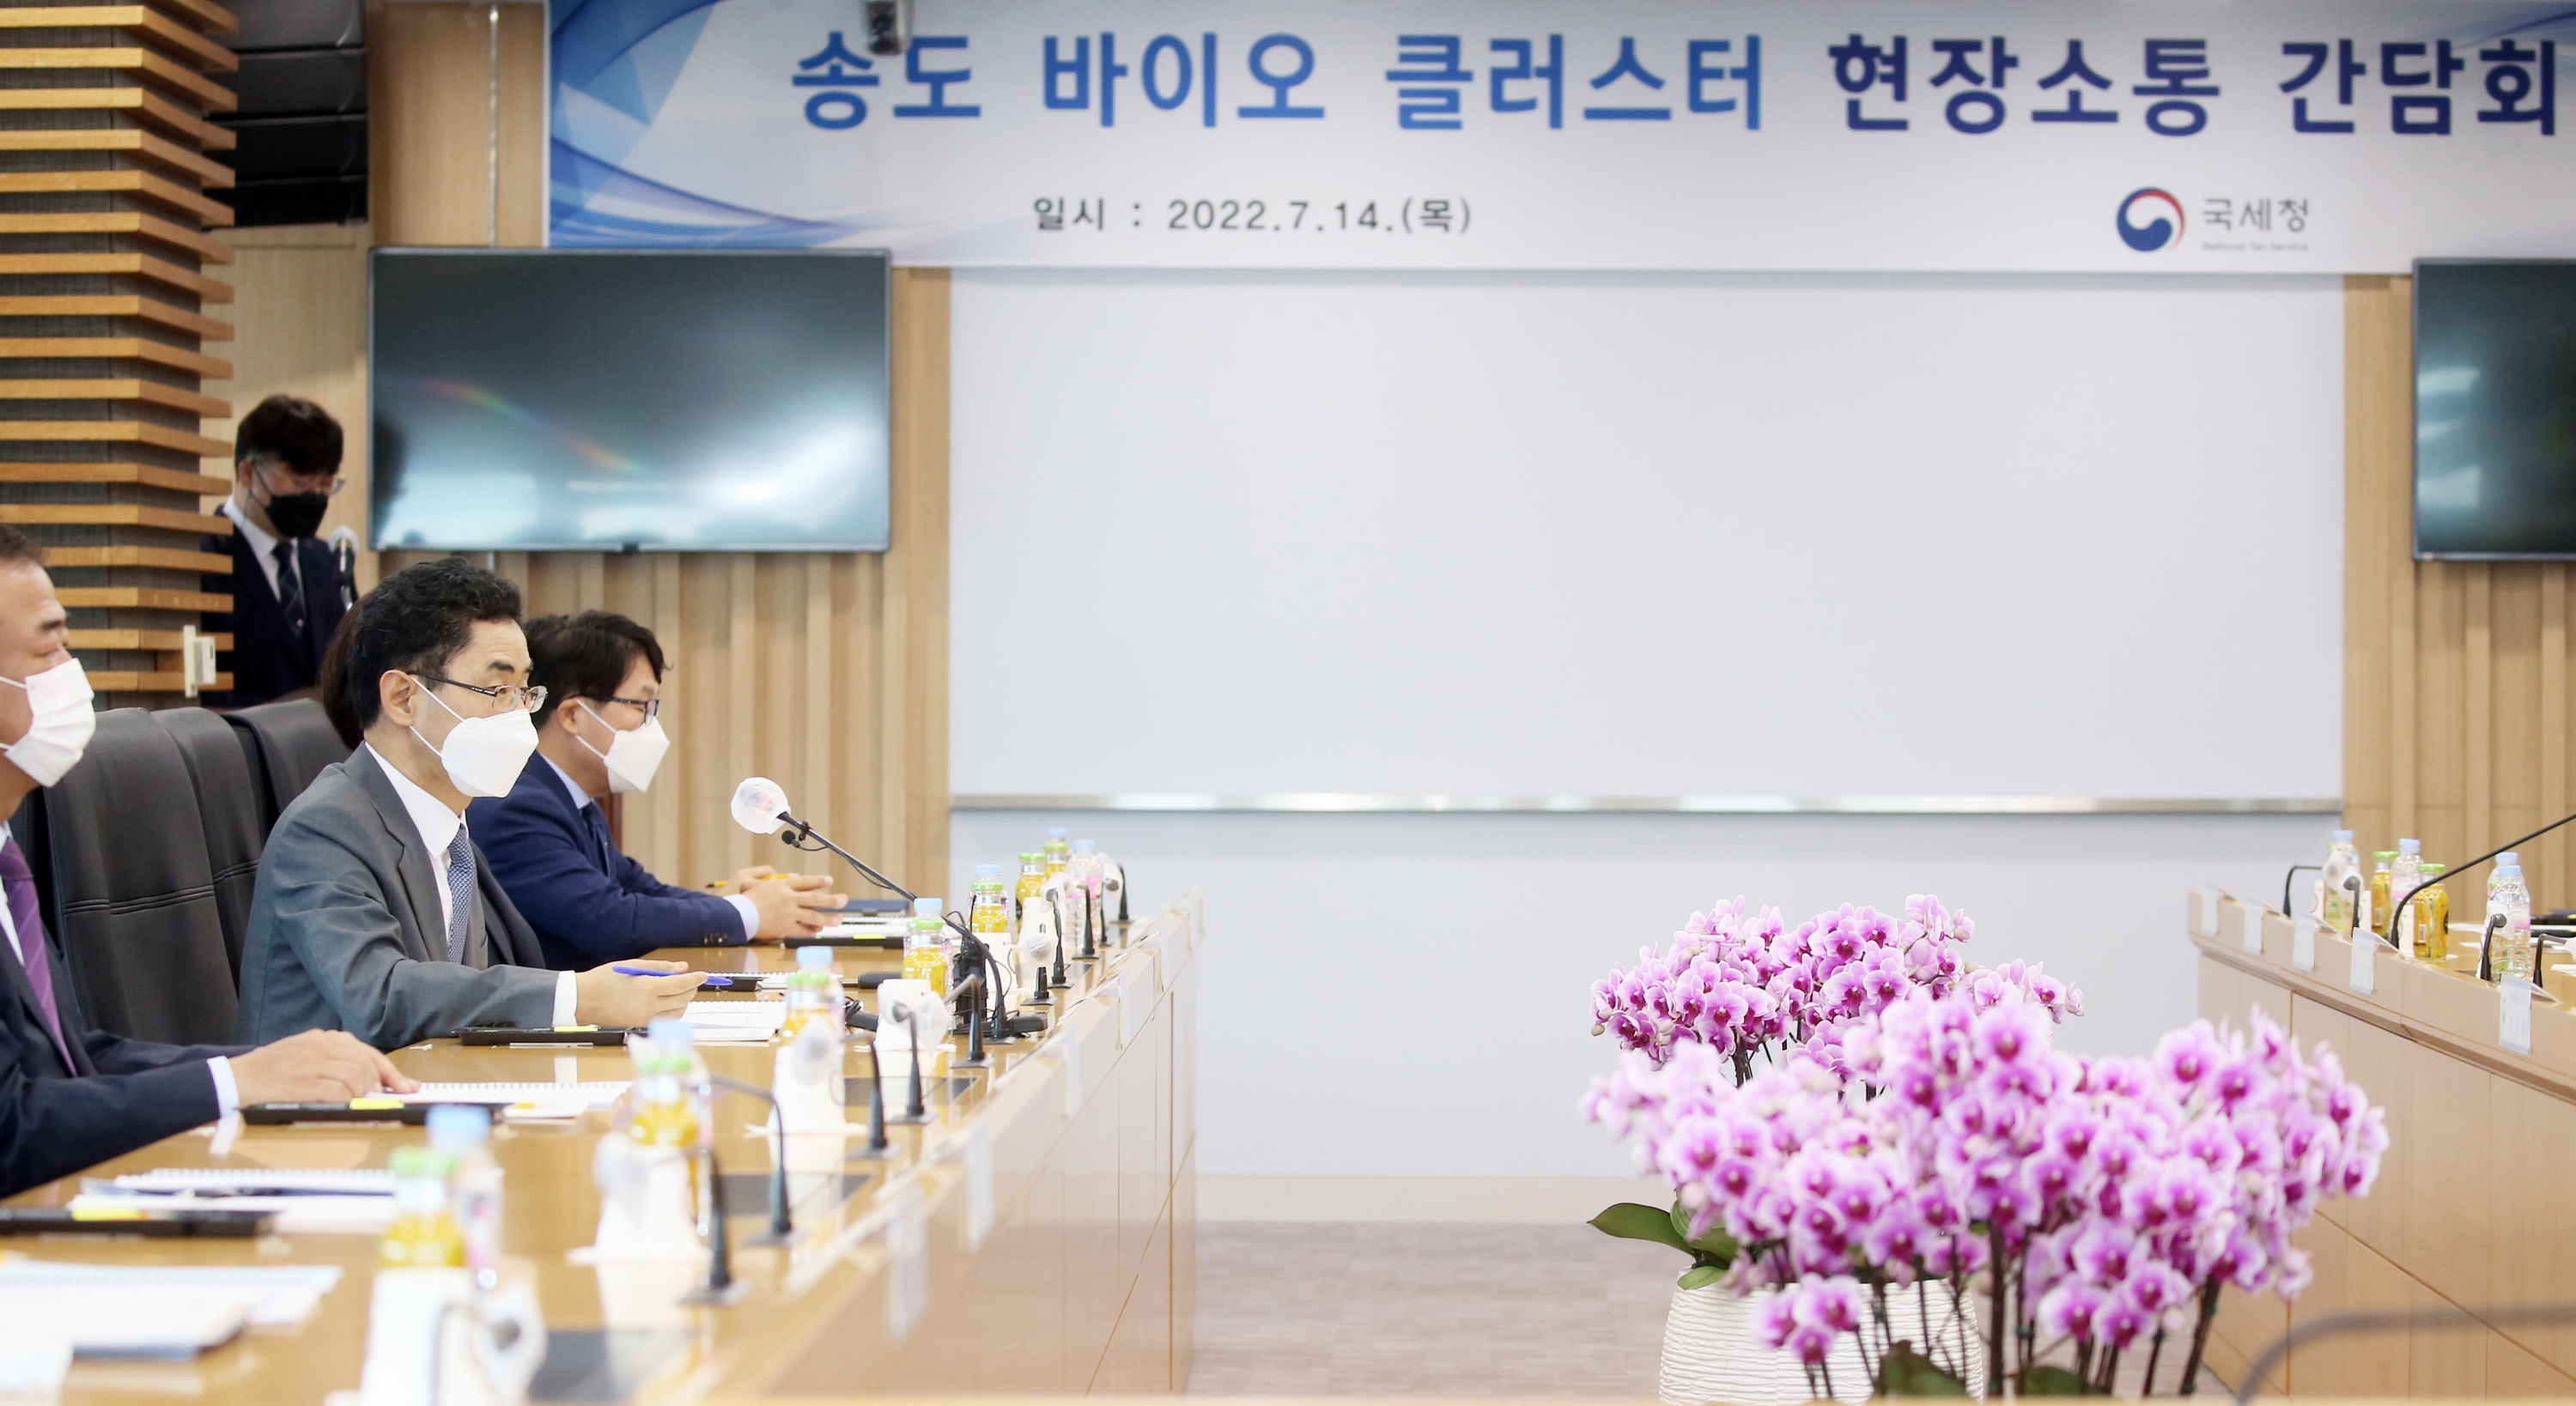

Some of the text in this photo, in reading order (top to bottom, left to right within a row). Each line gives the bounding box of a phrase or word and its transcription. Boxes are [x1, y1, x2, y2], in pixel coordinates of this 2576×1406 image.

[792, 30, 2556, 137] 송도 바이오 클러스터 현장소통 간담회
[1033, 197, 1104, 232] 일시
[1168, 197, 1471, 233] 2022.7.14.(목)
[2202, 197, 2309, 233] 국세청
